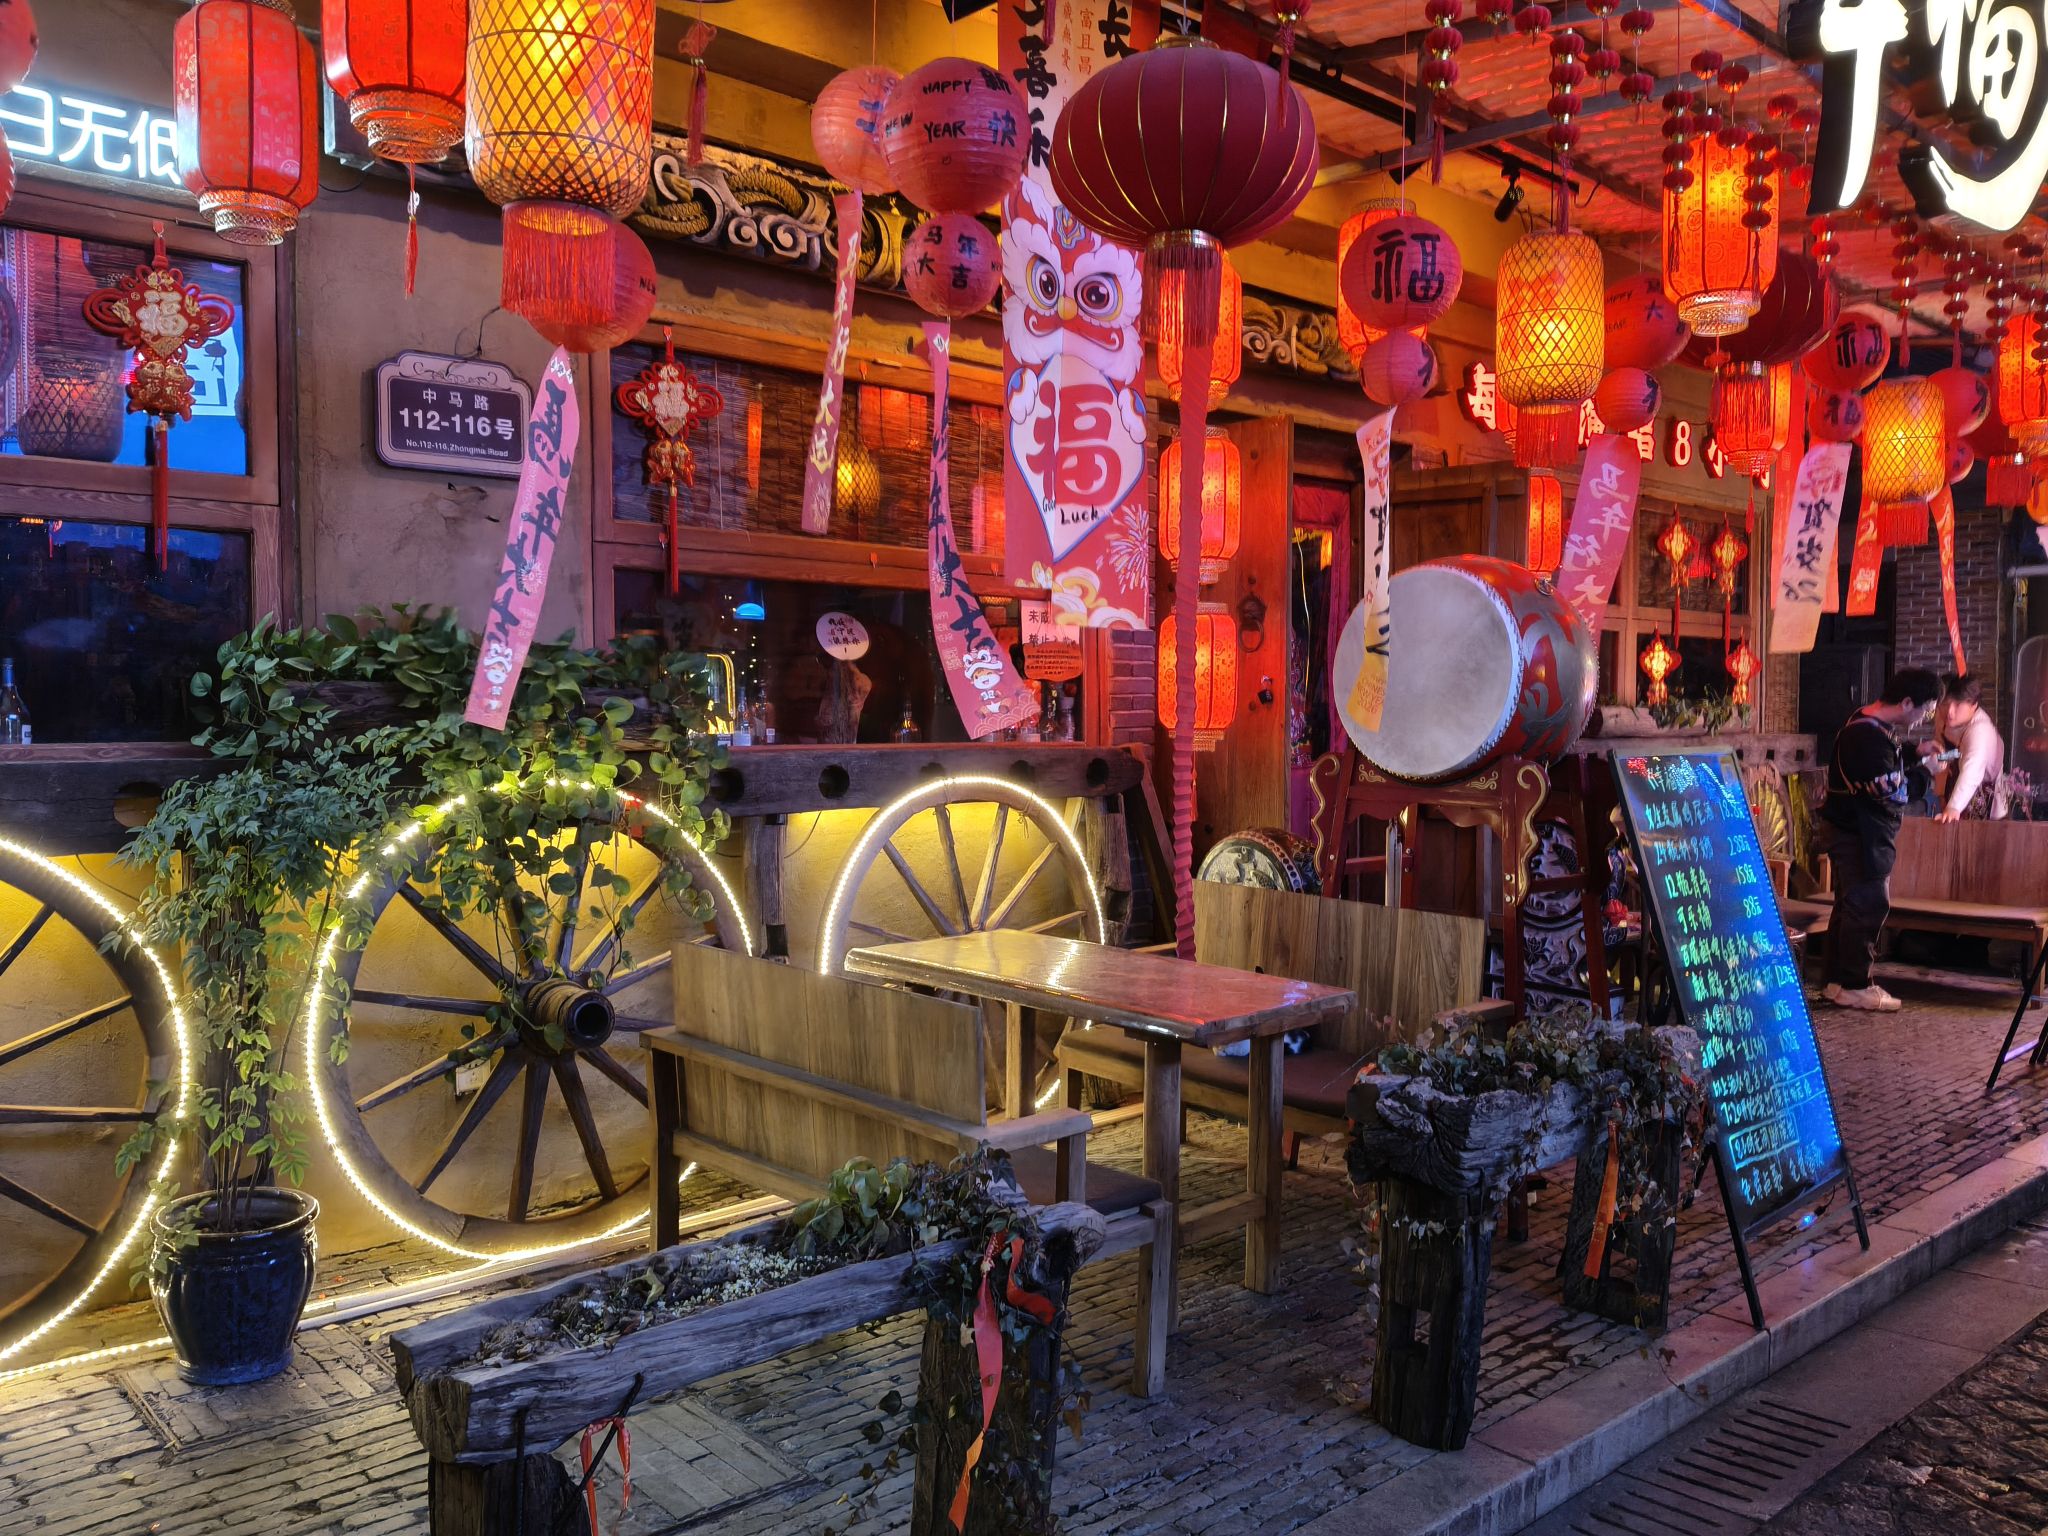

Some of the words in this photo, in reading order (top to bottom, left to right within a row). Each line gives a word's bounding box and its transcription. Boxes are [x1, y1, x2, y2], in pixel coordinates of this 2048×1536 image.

[922, 78, 972, 95] HAPPY
[923, 119, 967, 143] YEAR
[1370, 228, 1445, 305] 福
[422, 387, 490, 411] 中马路
[400, 407, 515, 441] 112-116号
[488, 448, 509, 458] Road
[1026, 379, 1122, 508] 福
[1060, 504, 1100, 525] Luck
[1727, 836, 1752, 856] 288元
[1665, 865, 1711, 899] 12瓶青岛
[1736, 864, 1757, 886] 158元
[1677, 900, 1712, 934] 可乐桶
[1743, 896, 1763, 918] 88元
